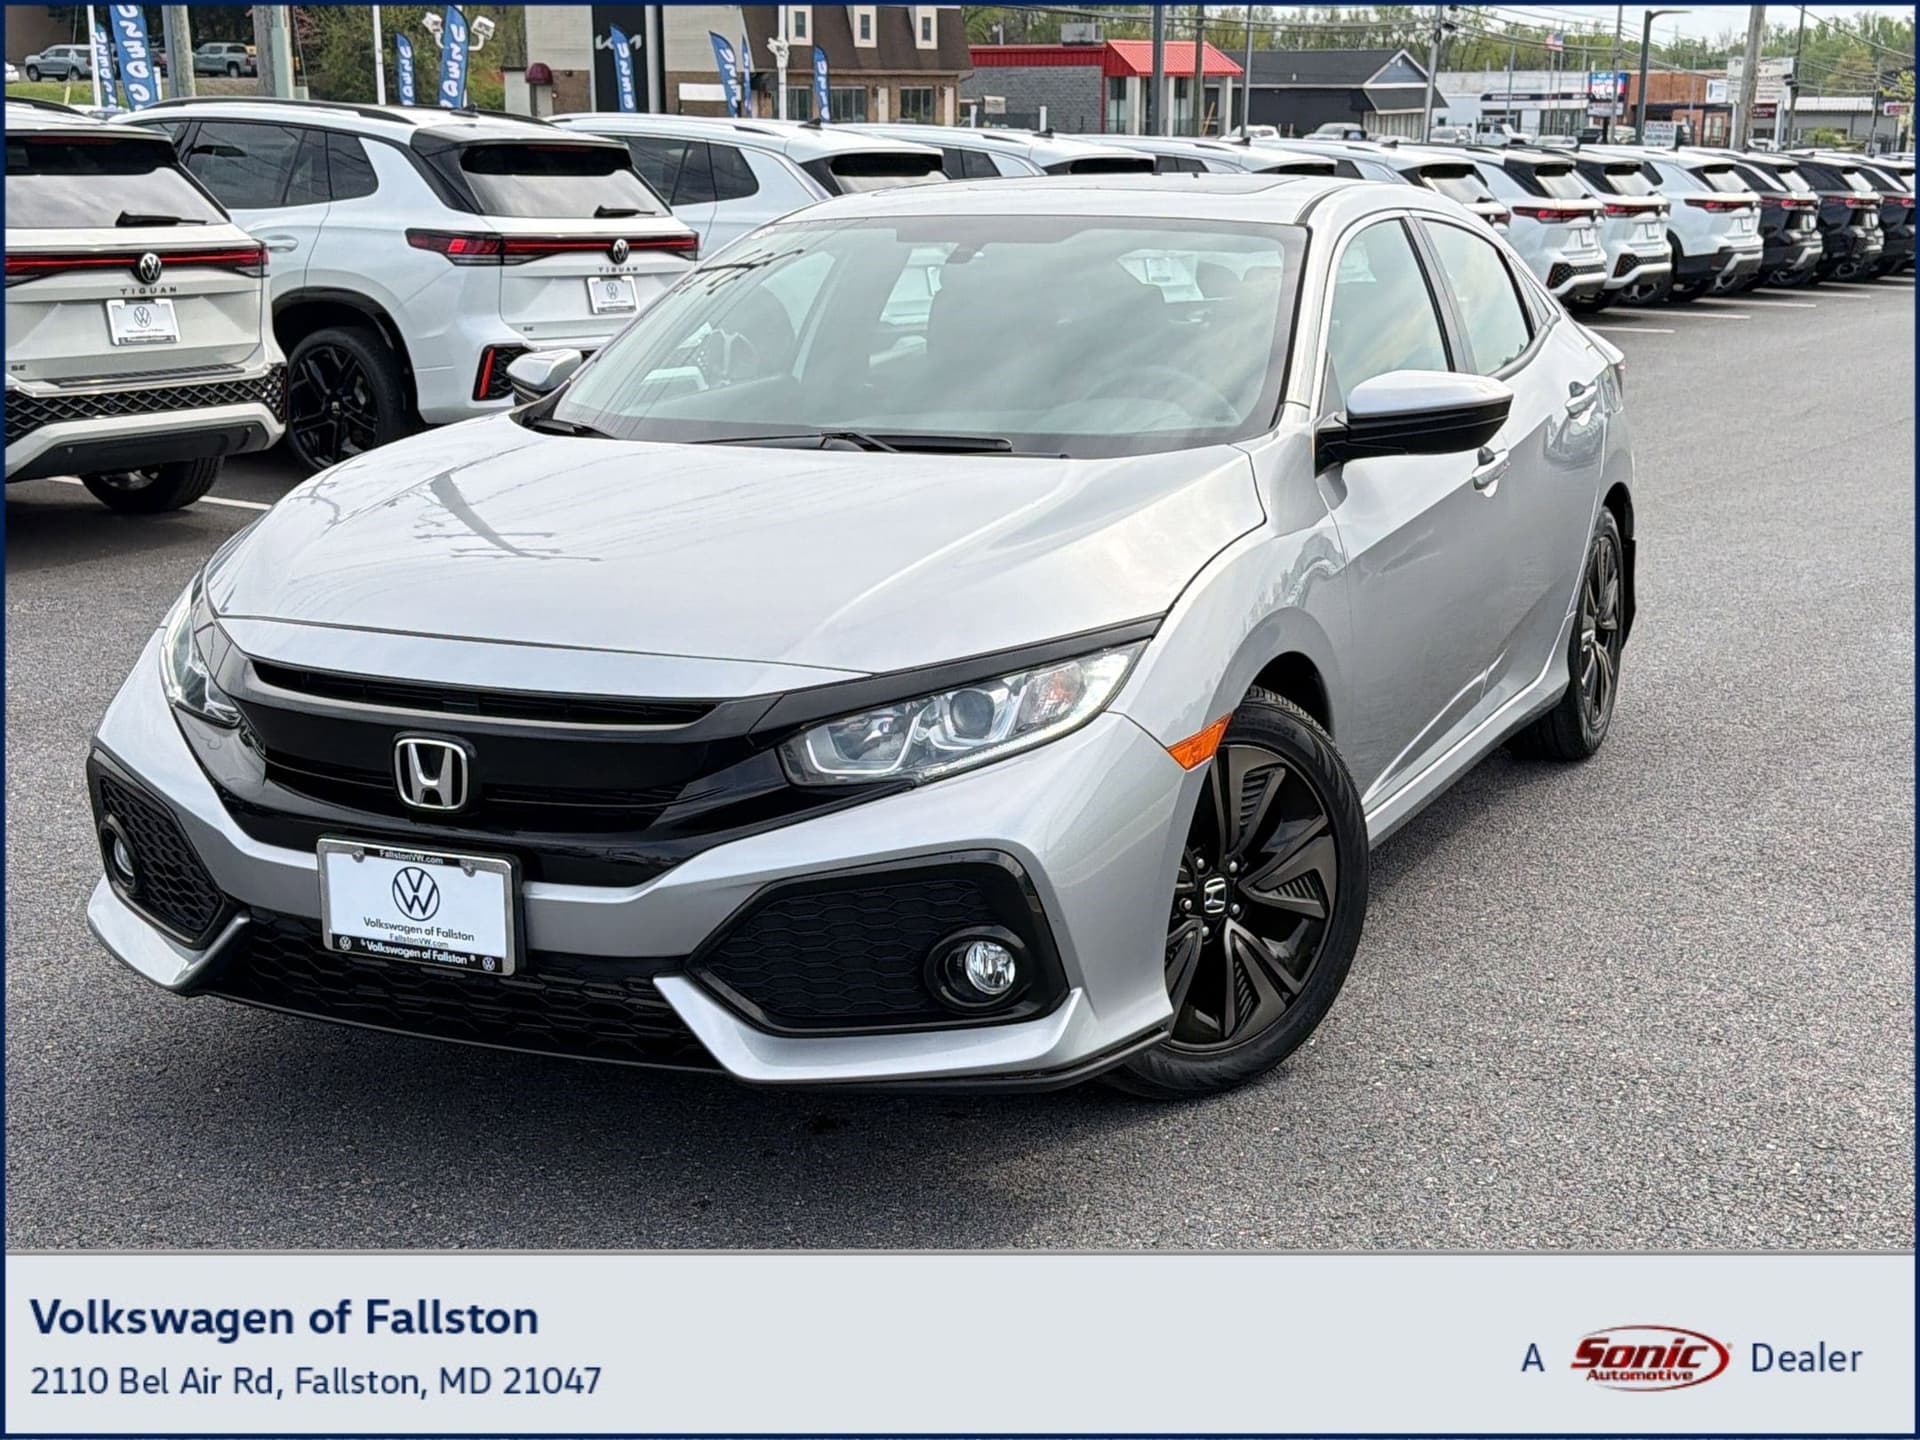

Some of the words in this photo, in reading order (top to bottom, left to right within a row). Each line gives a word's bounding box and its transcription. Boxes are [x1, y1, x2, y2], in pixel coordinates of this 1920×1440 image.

[120, 286, 177, 295] TIGUAN
[363, 917, 423, 935] Volkswagen
[424, 926, 435, 936] of
[436, 928, 475, 942] Fallston
[366, 940, 421, 959] Volkswagen
[422, 951, 432, 960] of
[432, 950, 468, 965] Fallston
